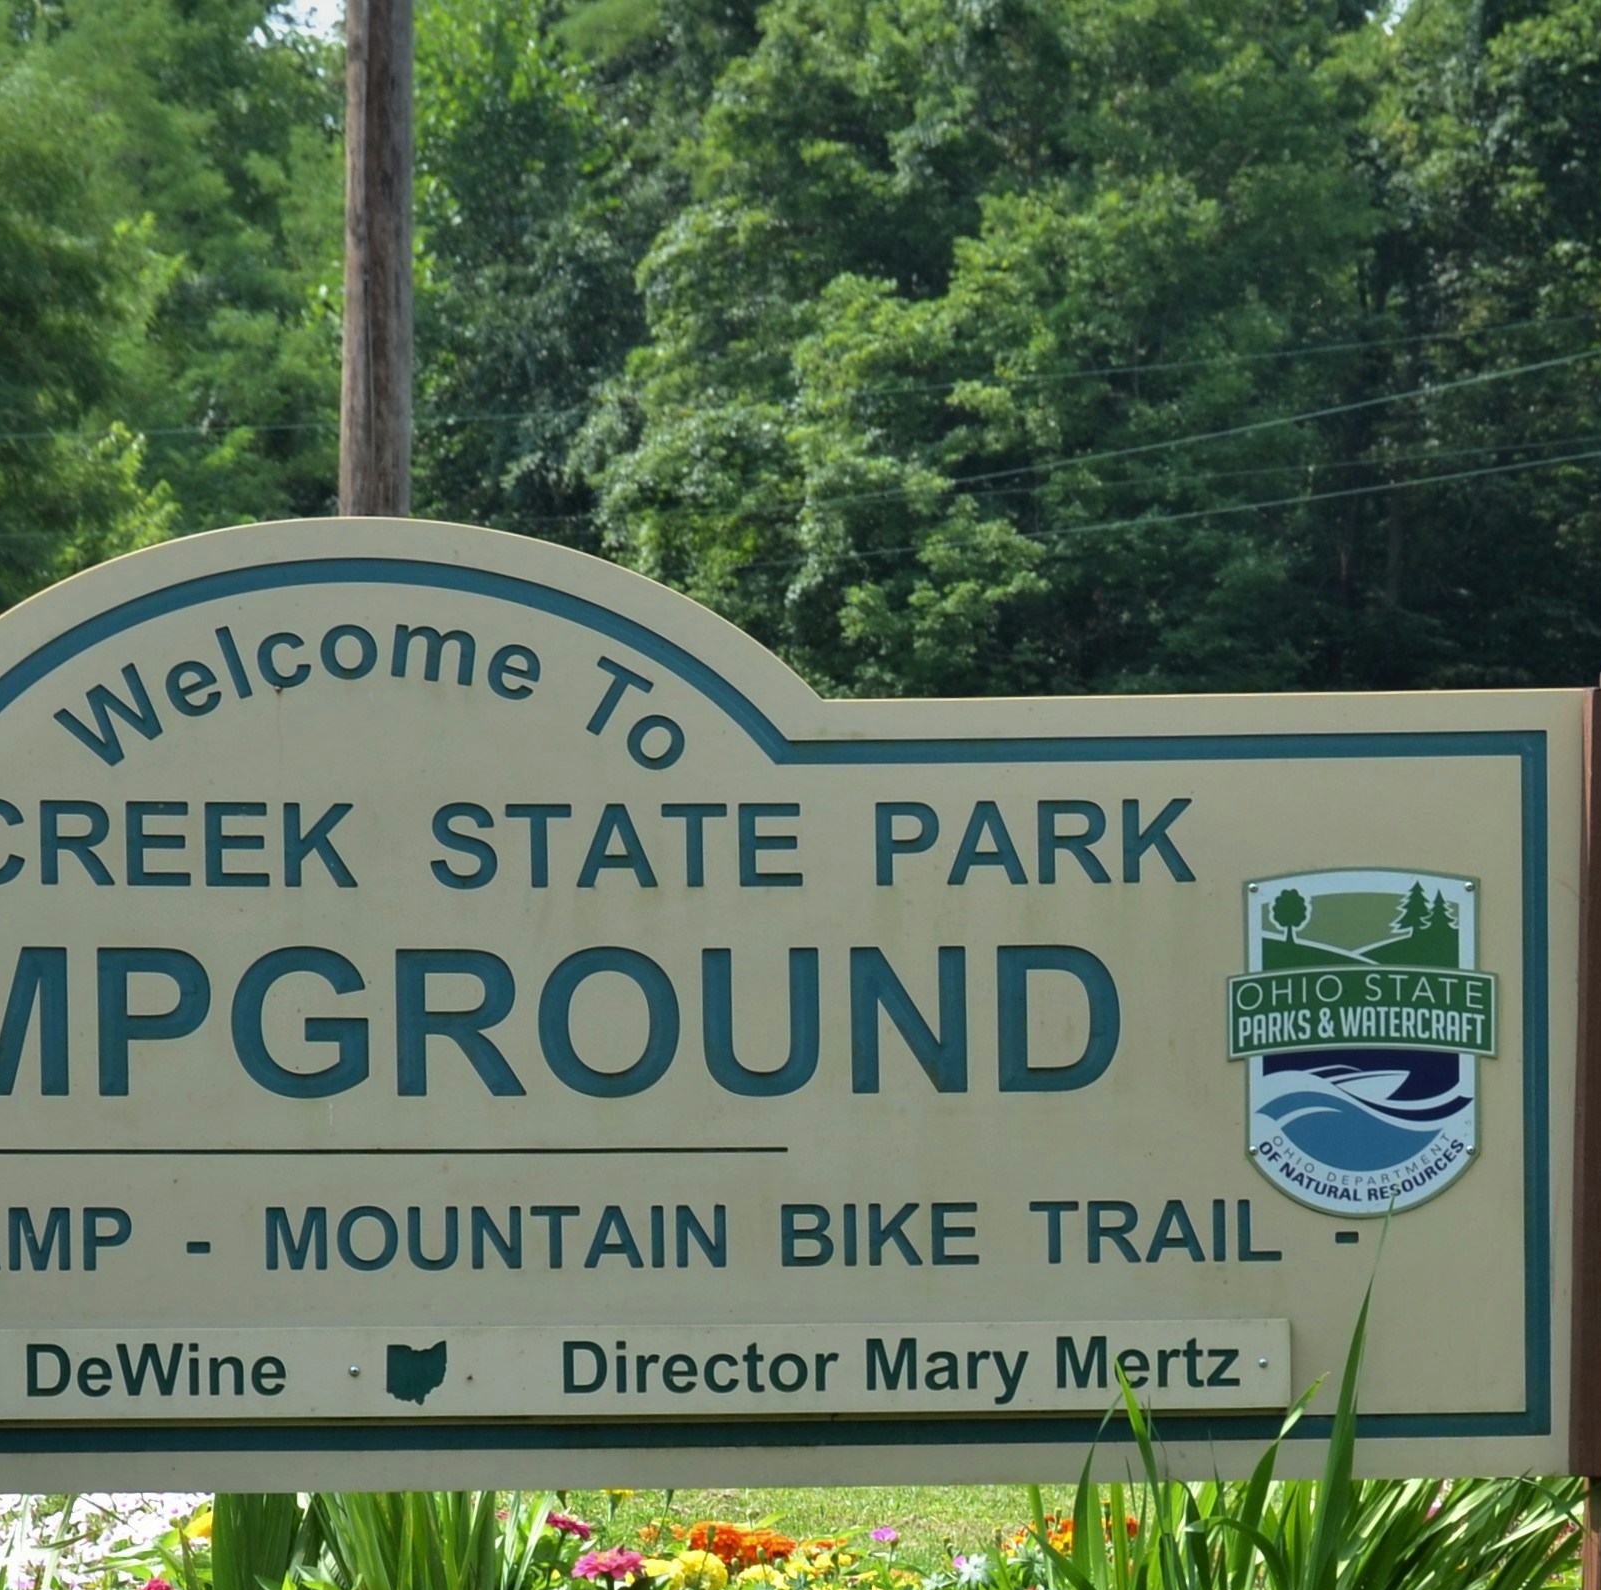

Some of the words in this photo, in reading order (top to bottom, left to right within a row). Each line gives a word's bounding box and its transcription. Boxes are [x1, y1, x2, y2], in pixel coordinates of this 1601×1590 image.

[53, 622, 541, 768] Welcome
[585, 656, 686, 772] To
[429, 801, 804, 890] STATE
[874, 797, 1197, 887] PARK
[1236, 974, 1343, 1011] OHIO
[1364, 973, 1485, 1010] STATE
[1238, 1008, 1312, 1048] PARKS
[1317, 1007, 1335, 1039] &
[1339, 1006, 1486, 1045] WATERCRAFT
[1258, 1140, 1281, 1163] OF
[1279, 1160, 1363, 1202] NATURAL
[1367, 1138, 1465, 1202] RESOURCES
[1272, 1135, 1314, 1174] OHIO
[1326, 1133, 1451, 1185] DEPARTMENT
[265, 1203, 727, 1272] MOUNTAIN
[780, 1201, 980, 1267] BIKE
[1028, 1198, 1283, 1265] TRAIL
[26, 1342, 287, 1398] DeWine
[562, 1339, 840, 1394] Director
[864, 1337, 1029, 1405] Mary
[1055, 1335, 1241, 1389] Mertz
